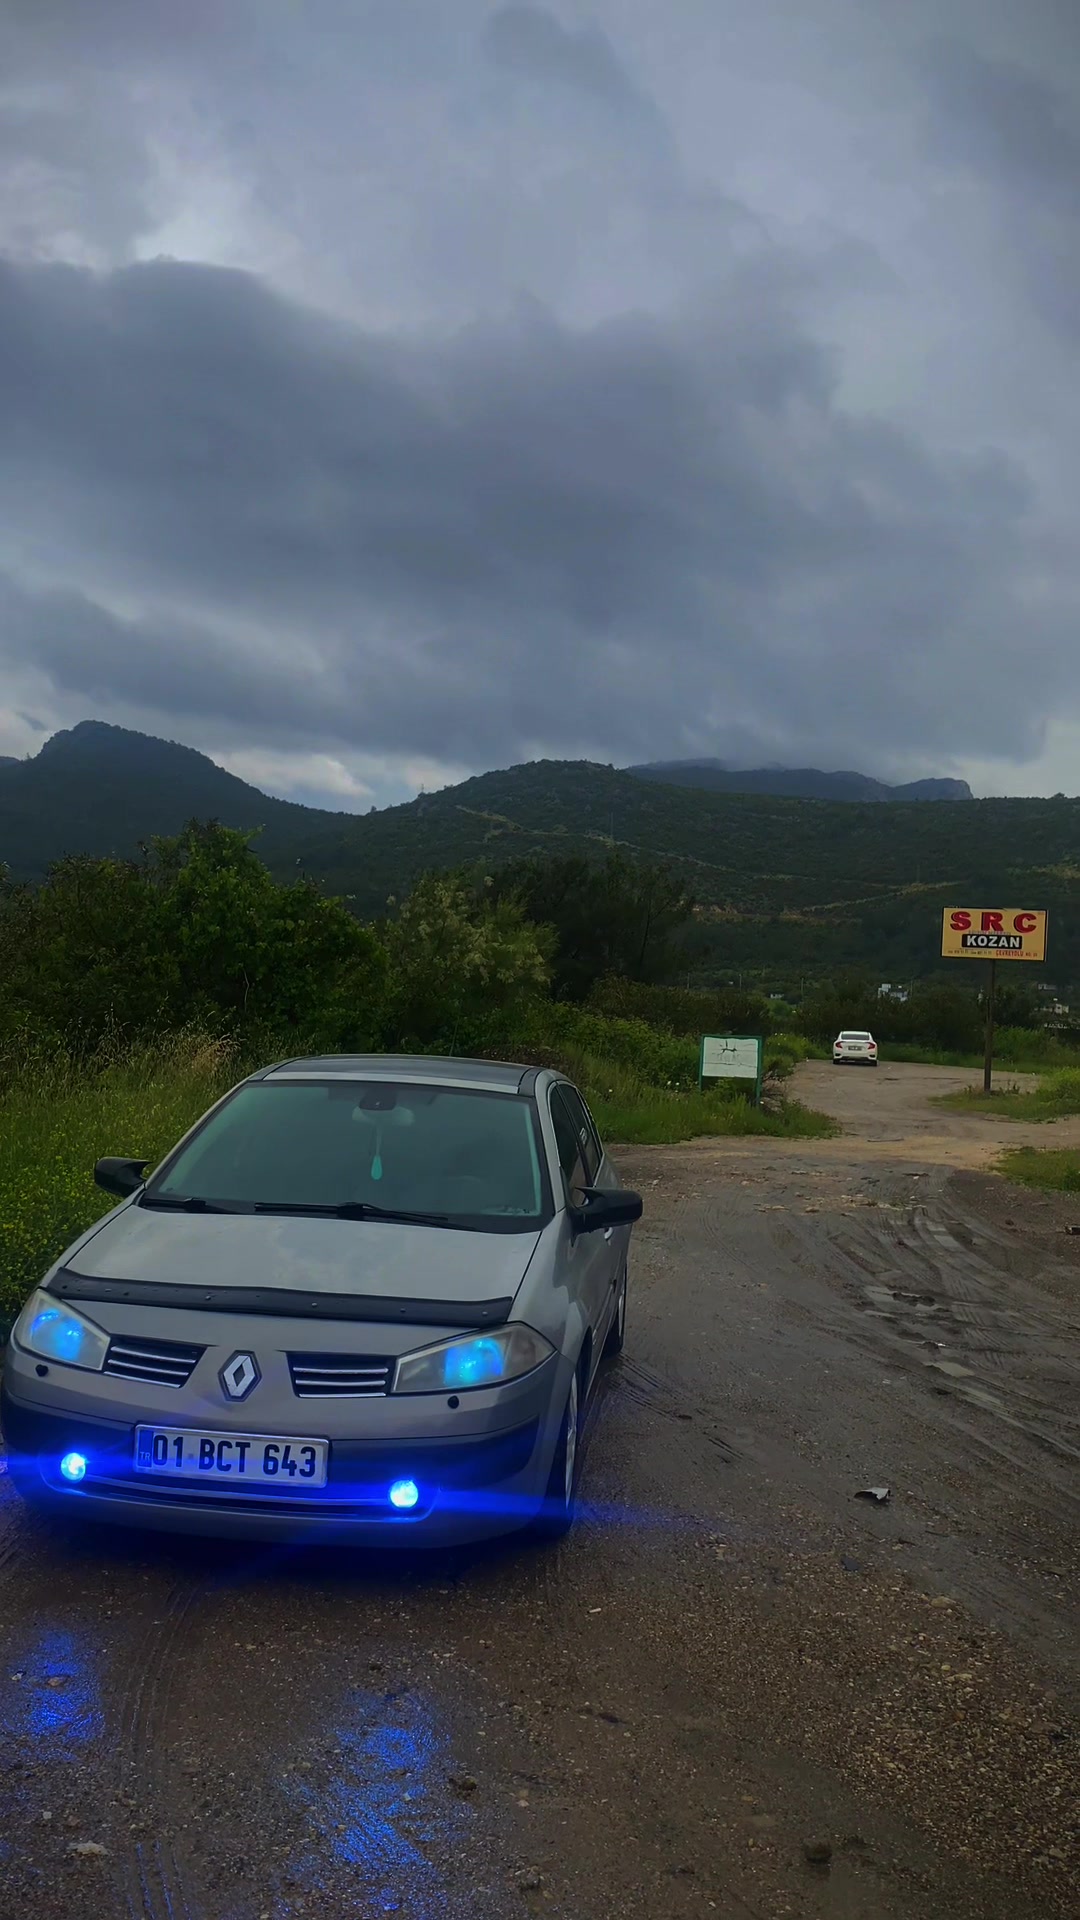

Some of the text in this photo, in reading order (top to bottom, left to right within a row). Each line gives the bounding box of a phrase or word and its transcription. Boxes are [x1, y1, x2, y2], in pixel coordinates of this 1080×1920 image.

[966, 935, 1020, 948] KOZAN
[139, 1434, 316, 1478] TR 01 BCT 643
